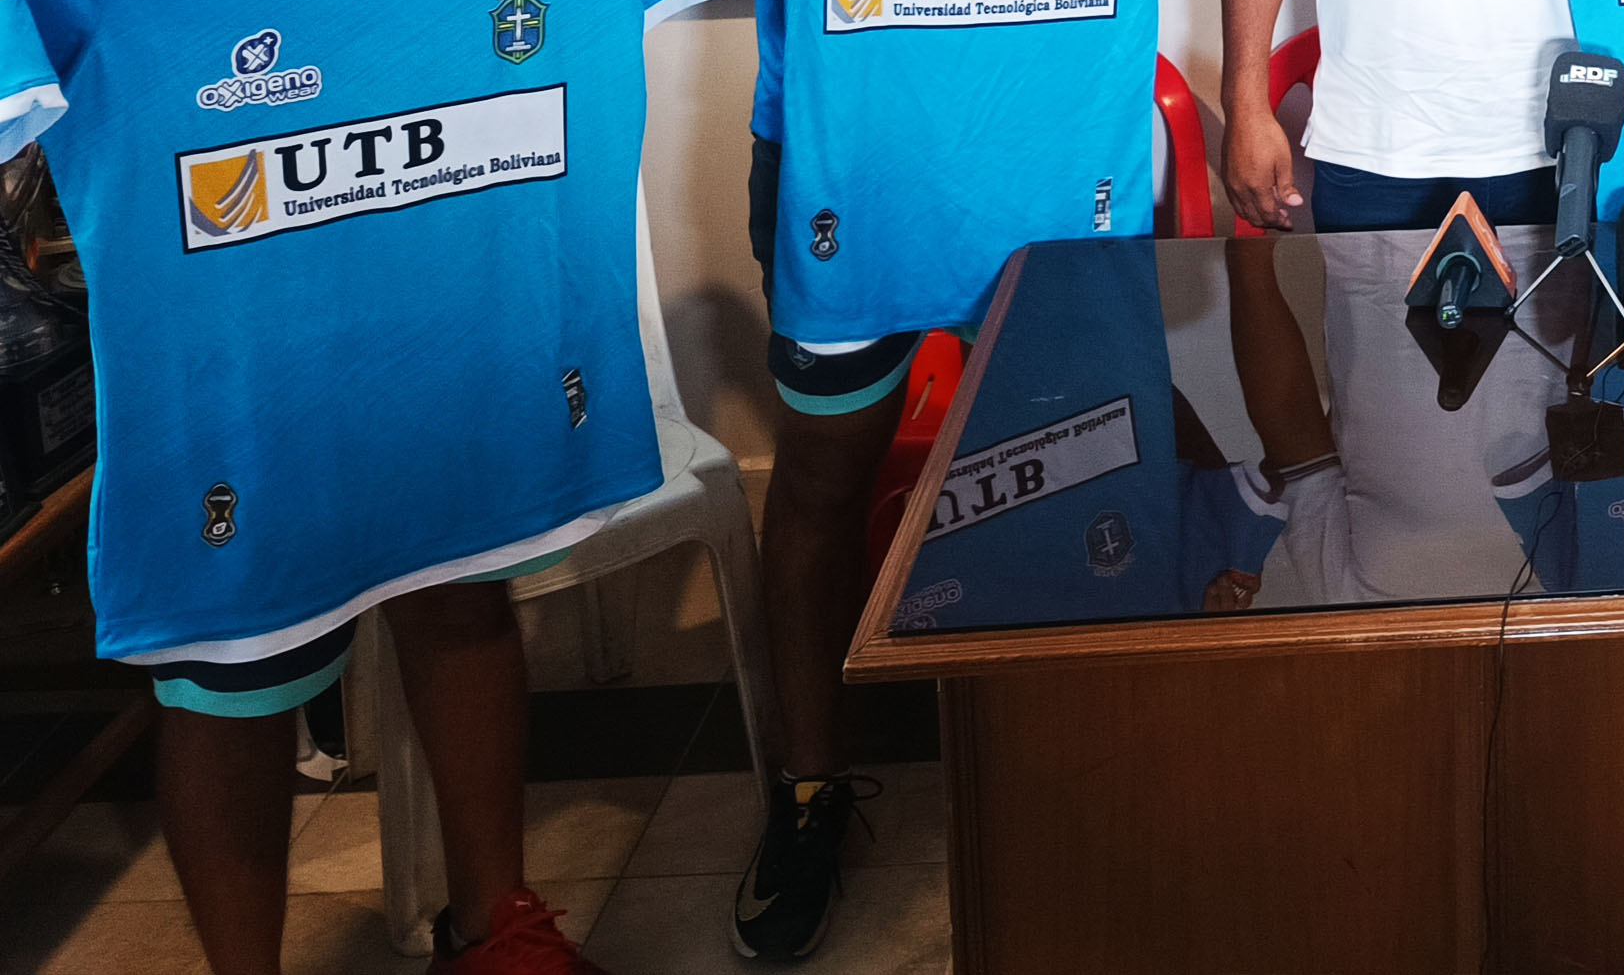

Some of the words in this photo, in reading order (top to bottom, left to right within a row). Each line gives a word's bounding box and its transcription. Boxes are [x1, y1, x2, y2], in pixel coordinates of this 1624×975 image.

[893, 1, 971, 17] Universidad
[976, 0, 1050, 18] Tecnológica
[1569, 64, 1618, 82] RDF
[275, 117, 445, 192] UTB
[284, 182, 386, 217] Universidad
[392, 164, 485, 196] Tecnológica
[489, 150, 561, 175] Boliviana
